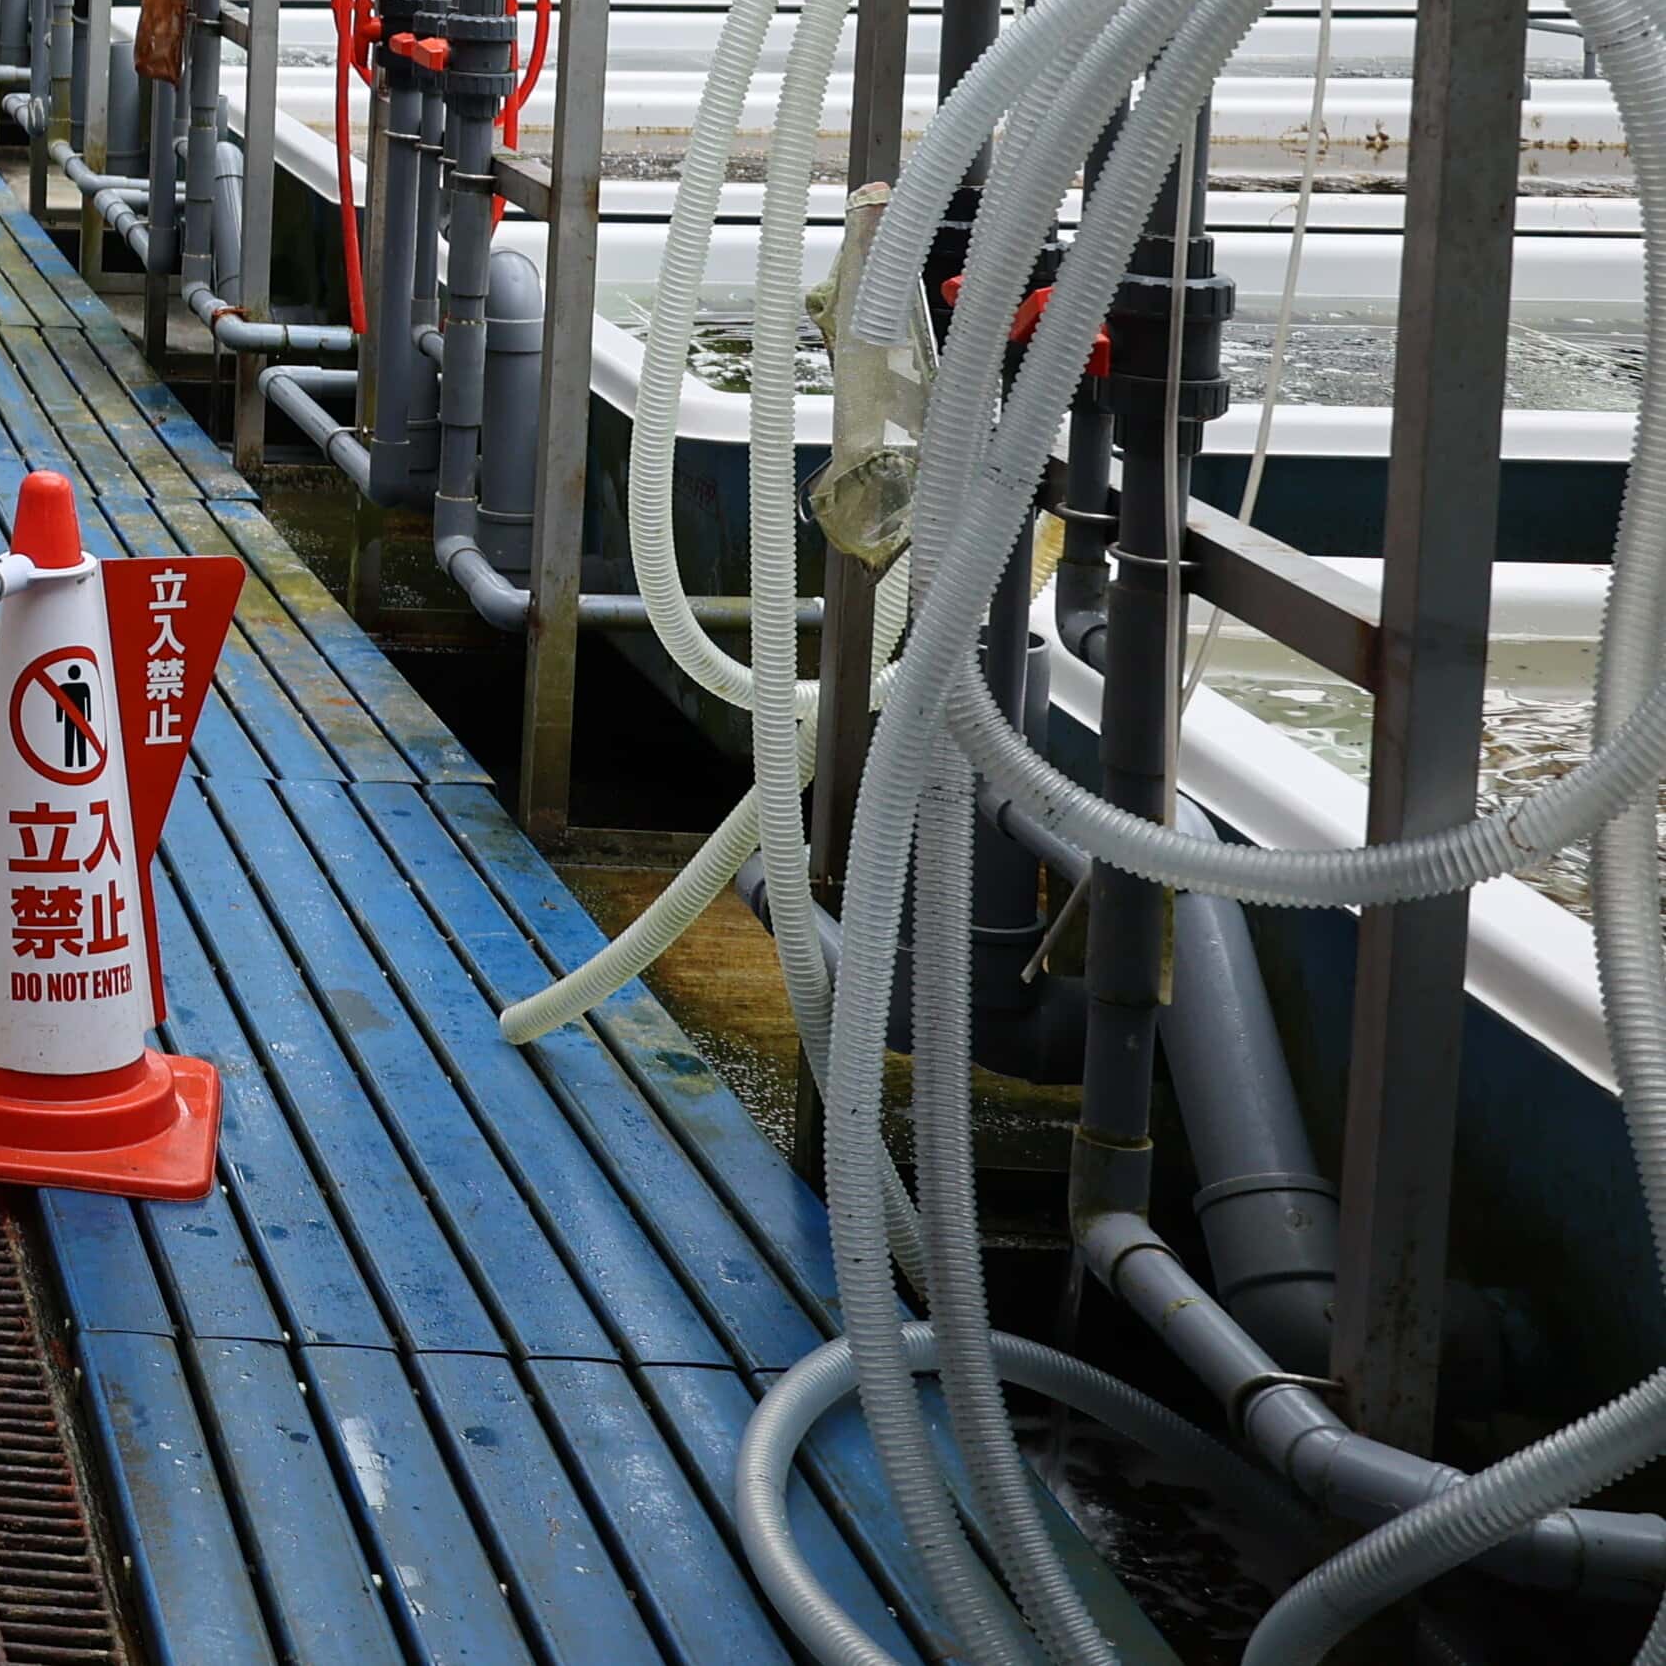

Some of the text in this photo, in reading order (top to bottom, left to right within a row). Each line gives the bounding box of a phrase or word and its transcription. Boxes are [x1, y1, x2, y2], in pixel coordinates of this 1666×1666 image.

[144, 568, 187, 745] 立入禁止
[8, 799, 122, 873] 立入
[11, 879, 129, 959] 禁止
[11, 963, 133, 1002] DO NOT ENTER
